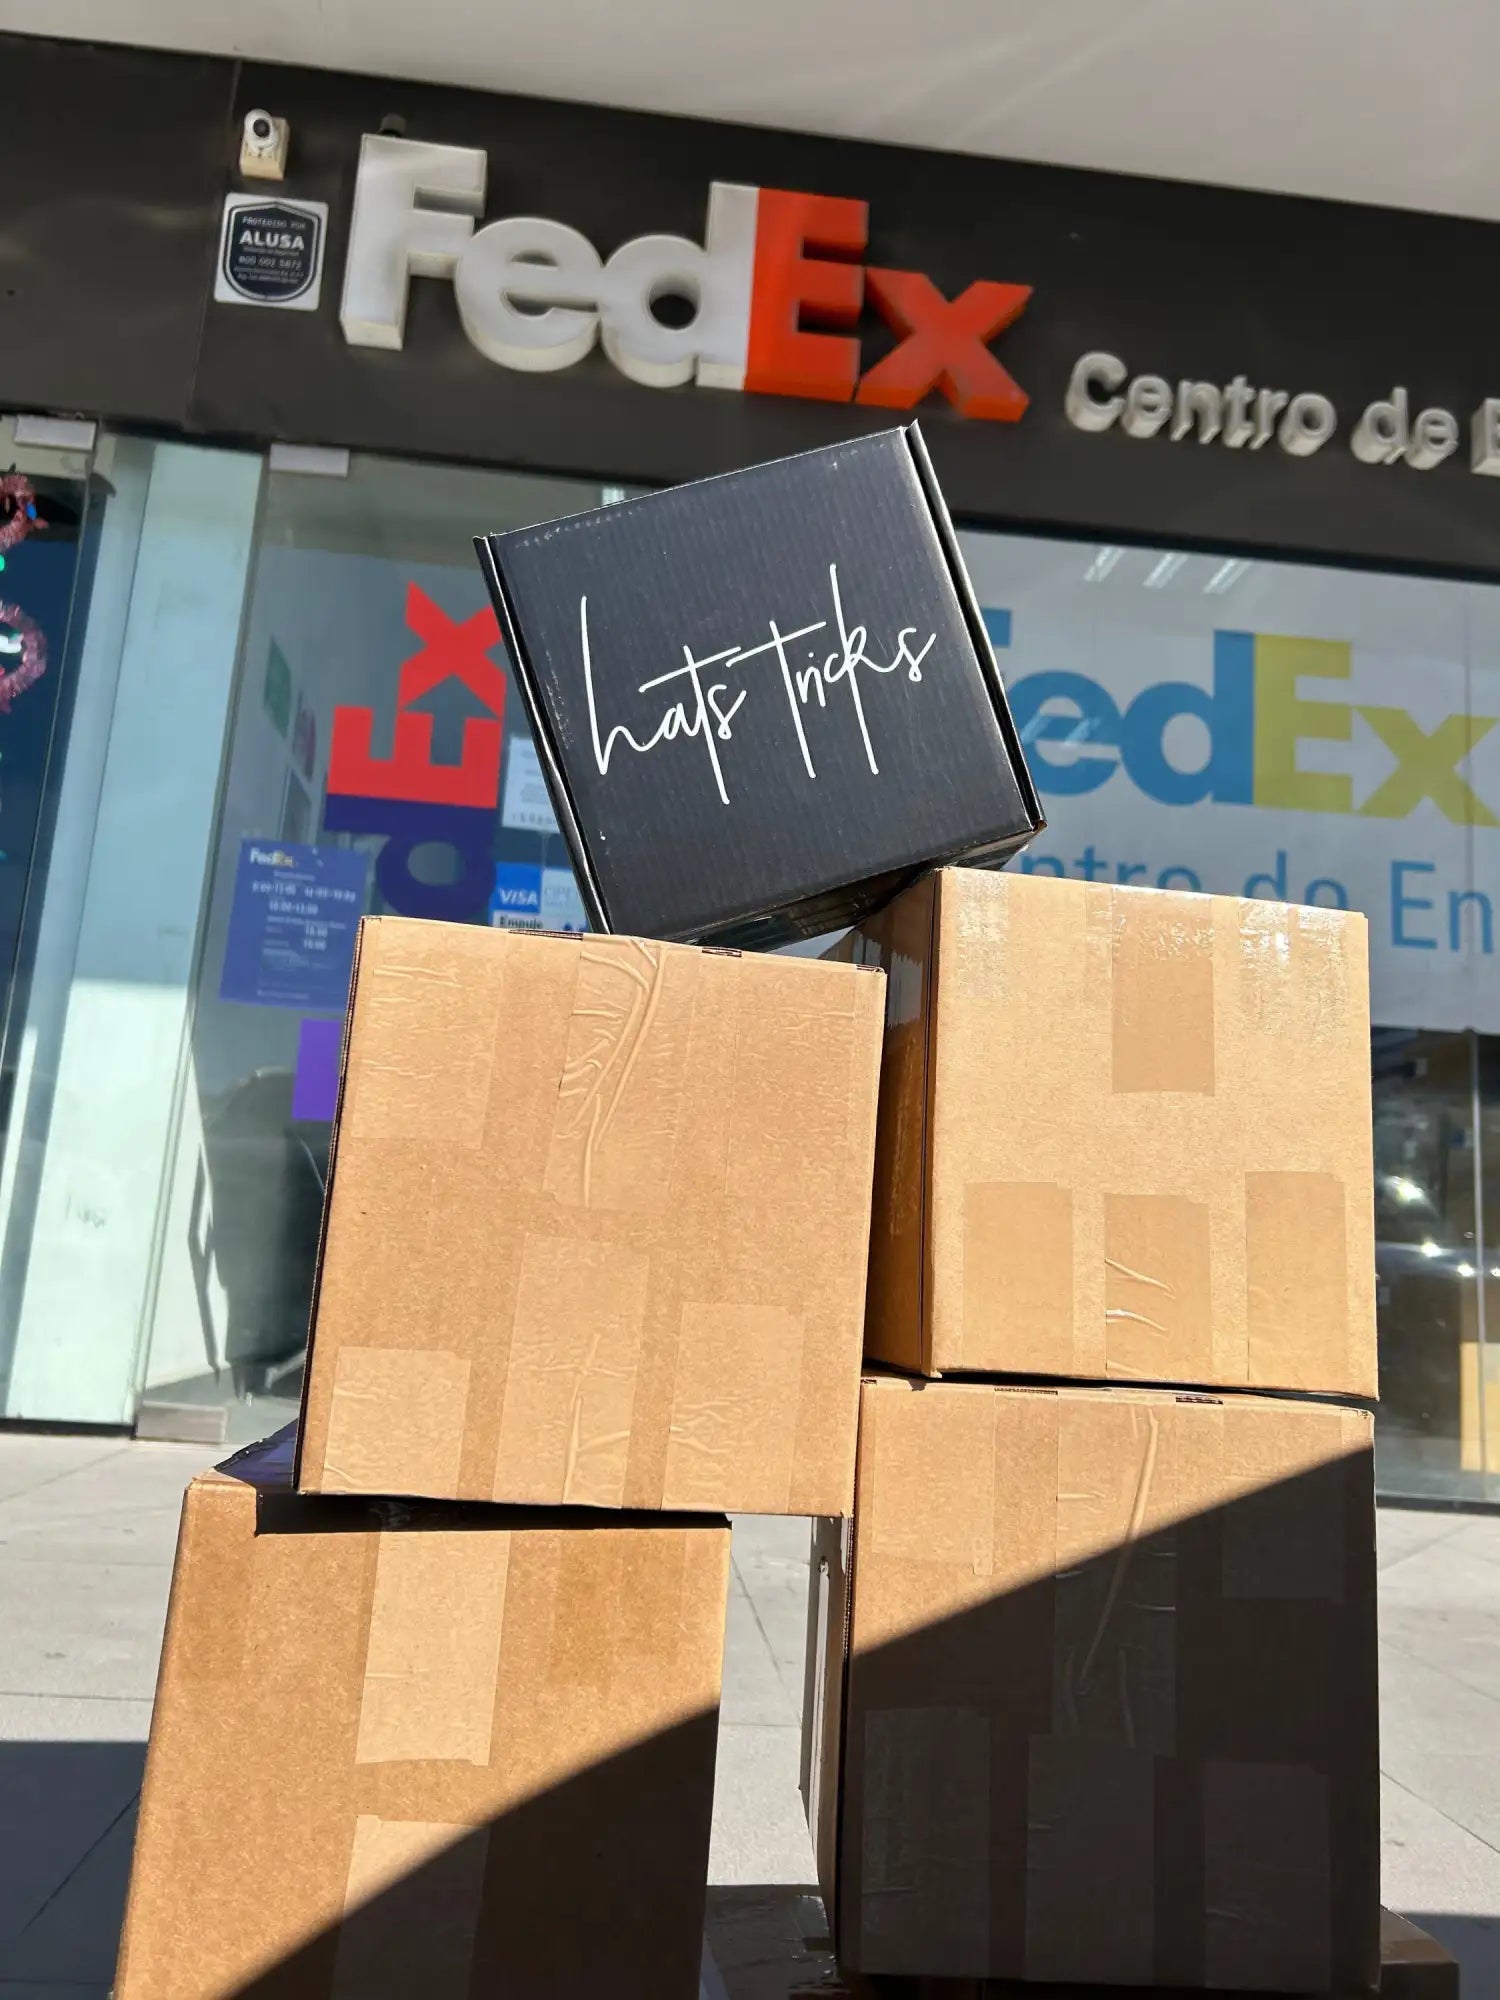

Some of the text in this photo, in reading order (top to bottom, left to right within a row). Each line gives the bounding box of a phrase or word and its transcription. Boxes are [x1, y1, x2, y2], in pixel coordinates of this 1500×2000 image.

[239, 230, 304, 251] ALUSA
[340, 134, 1033, 422] FedEx
[1064, 351, 1338, 457] Centro
[1350, 386, 1460, 471] de
[981, 608, 1500, 828] edEx
[499, 888, 538, 905] VISA
